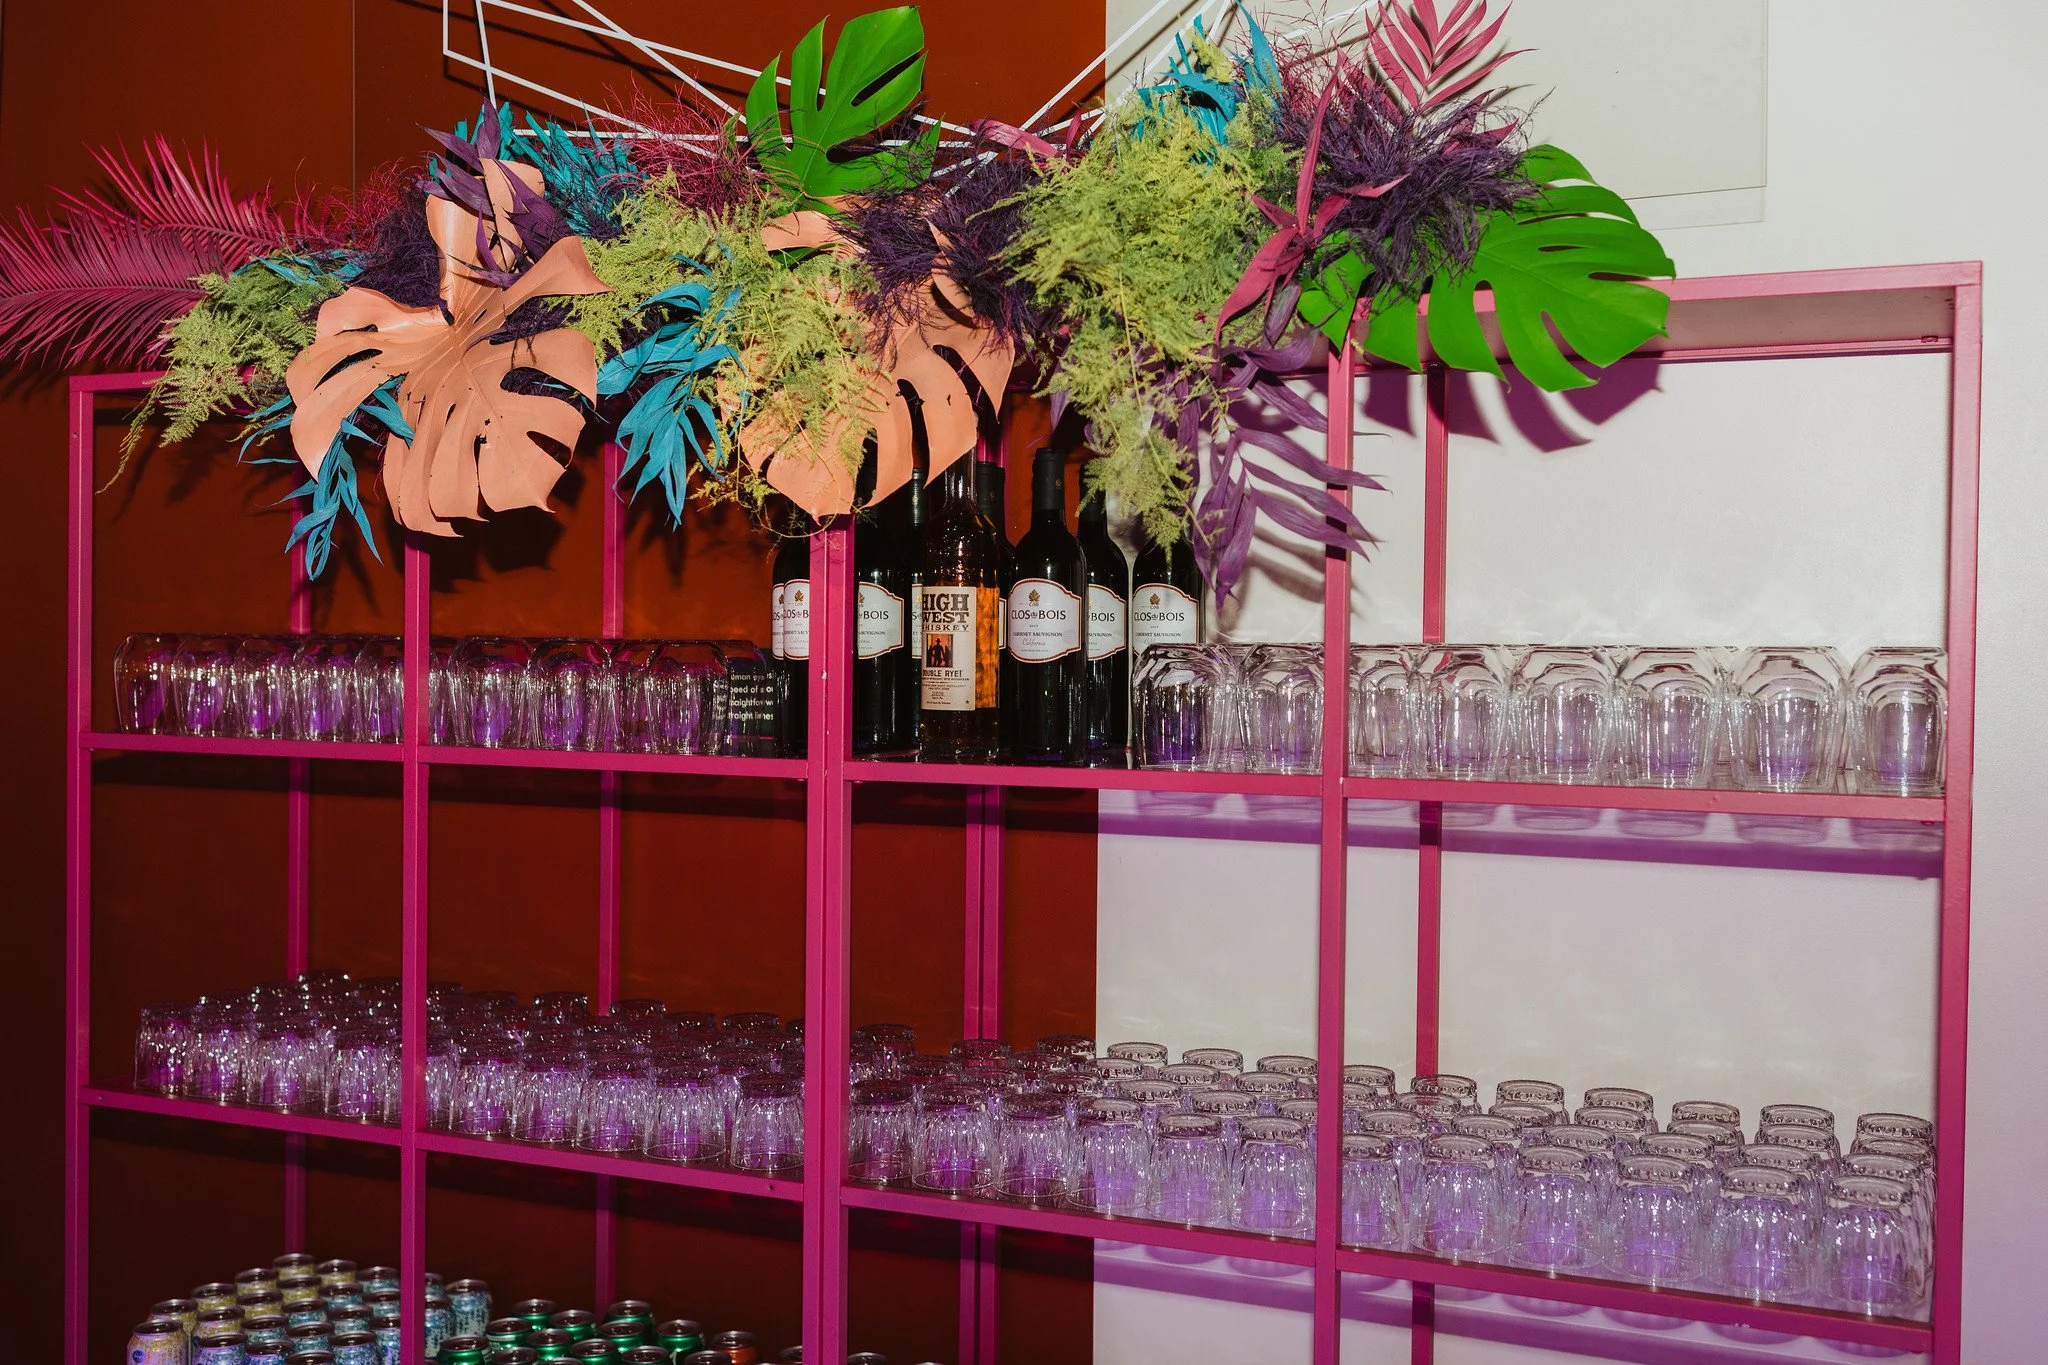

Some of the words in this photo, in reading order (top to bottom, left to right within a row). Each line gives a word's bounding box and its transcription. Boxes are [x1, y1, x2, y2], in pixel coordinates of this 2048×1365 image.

[922, 593, 969, 611] HIGH
[863, 610, 889, 620] BOIS
[922, 611, 969, 623] WEST
[1011, 609, 1030, 620] CLOS
[1038, 609, 1066, 620] BOIS
[1091, 612, 1116, 622] BOIS
[1133, 611, 1151, 622] CLOS
[1159, 612, 1185, 622] BOIS
[944, 669, 962, 678] RYE!
